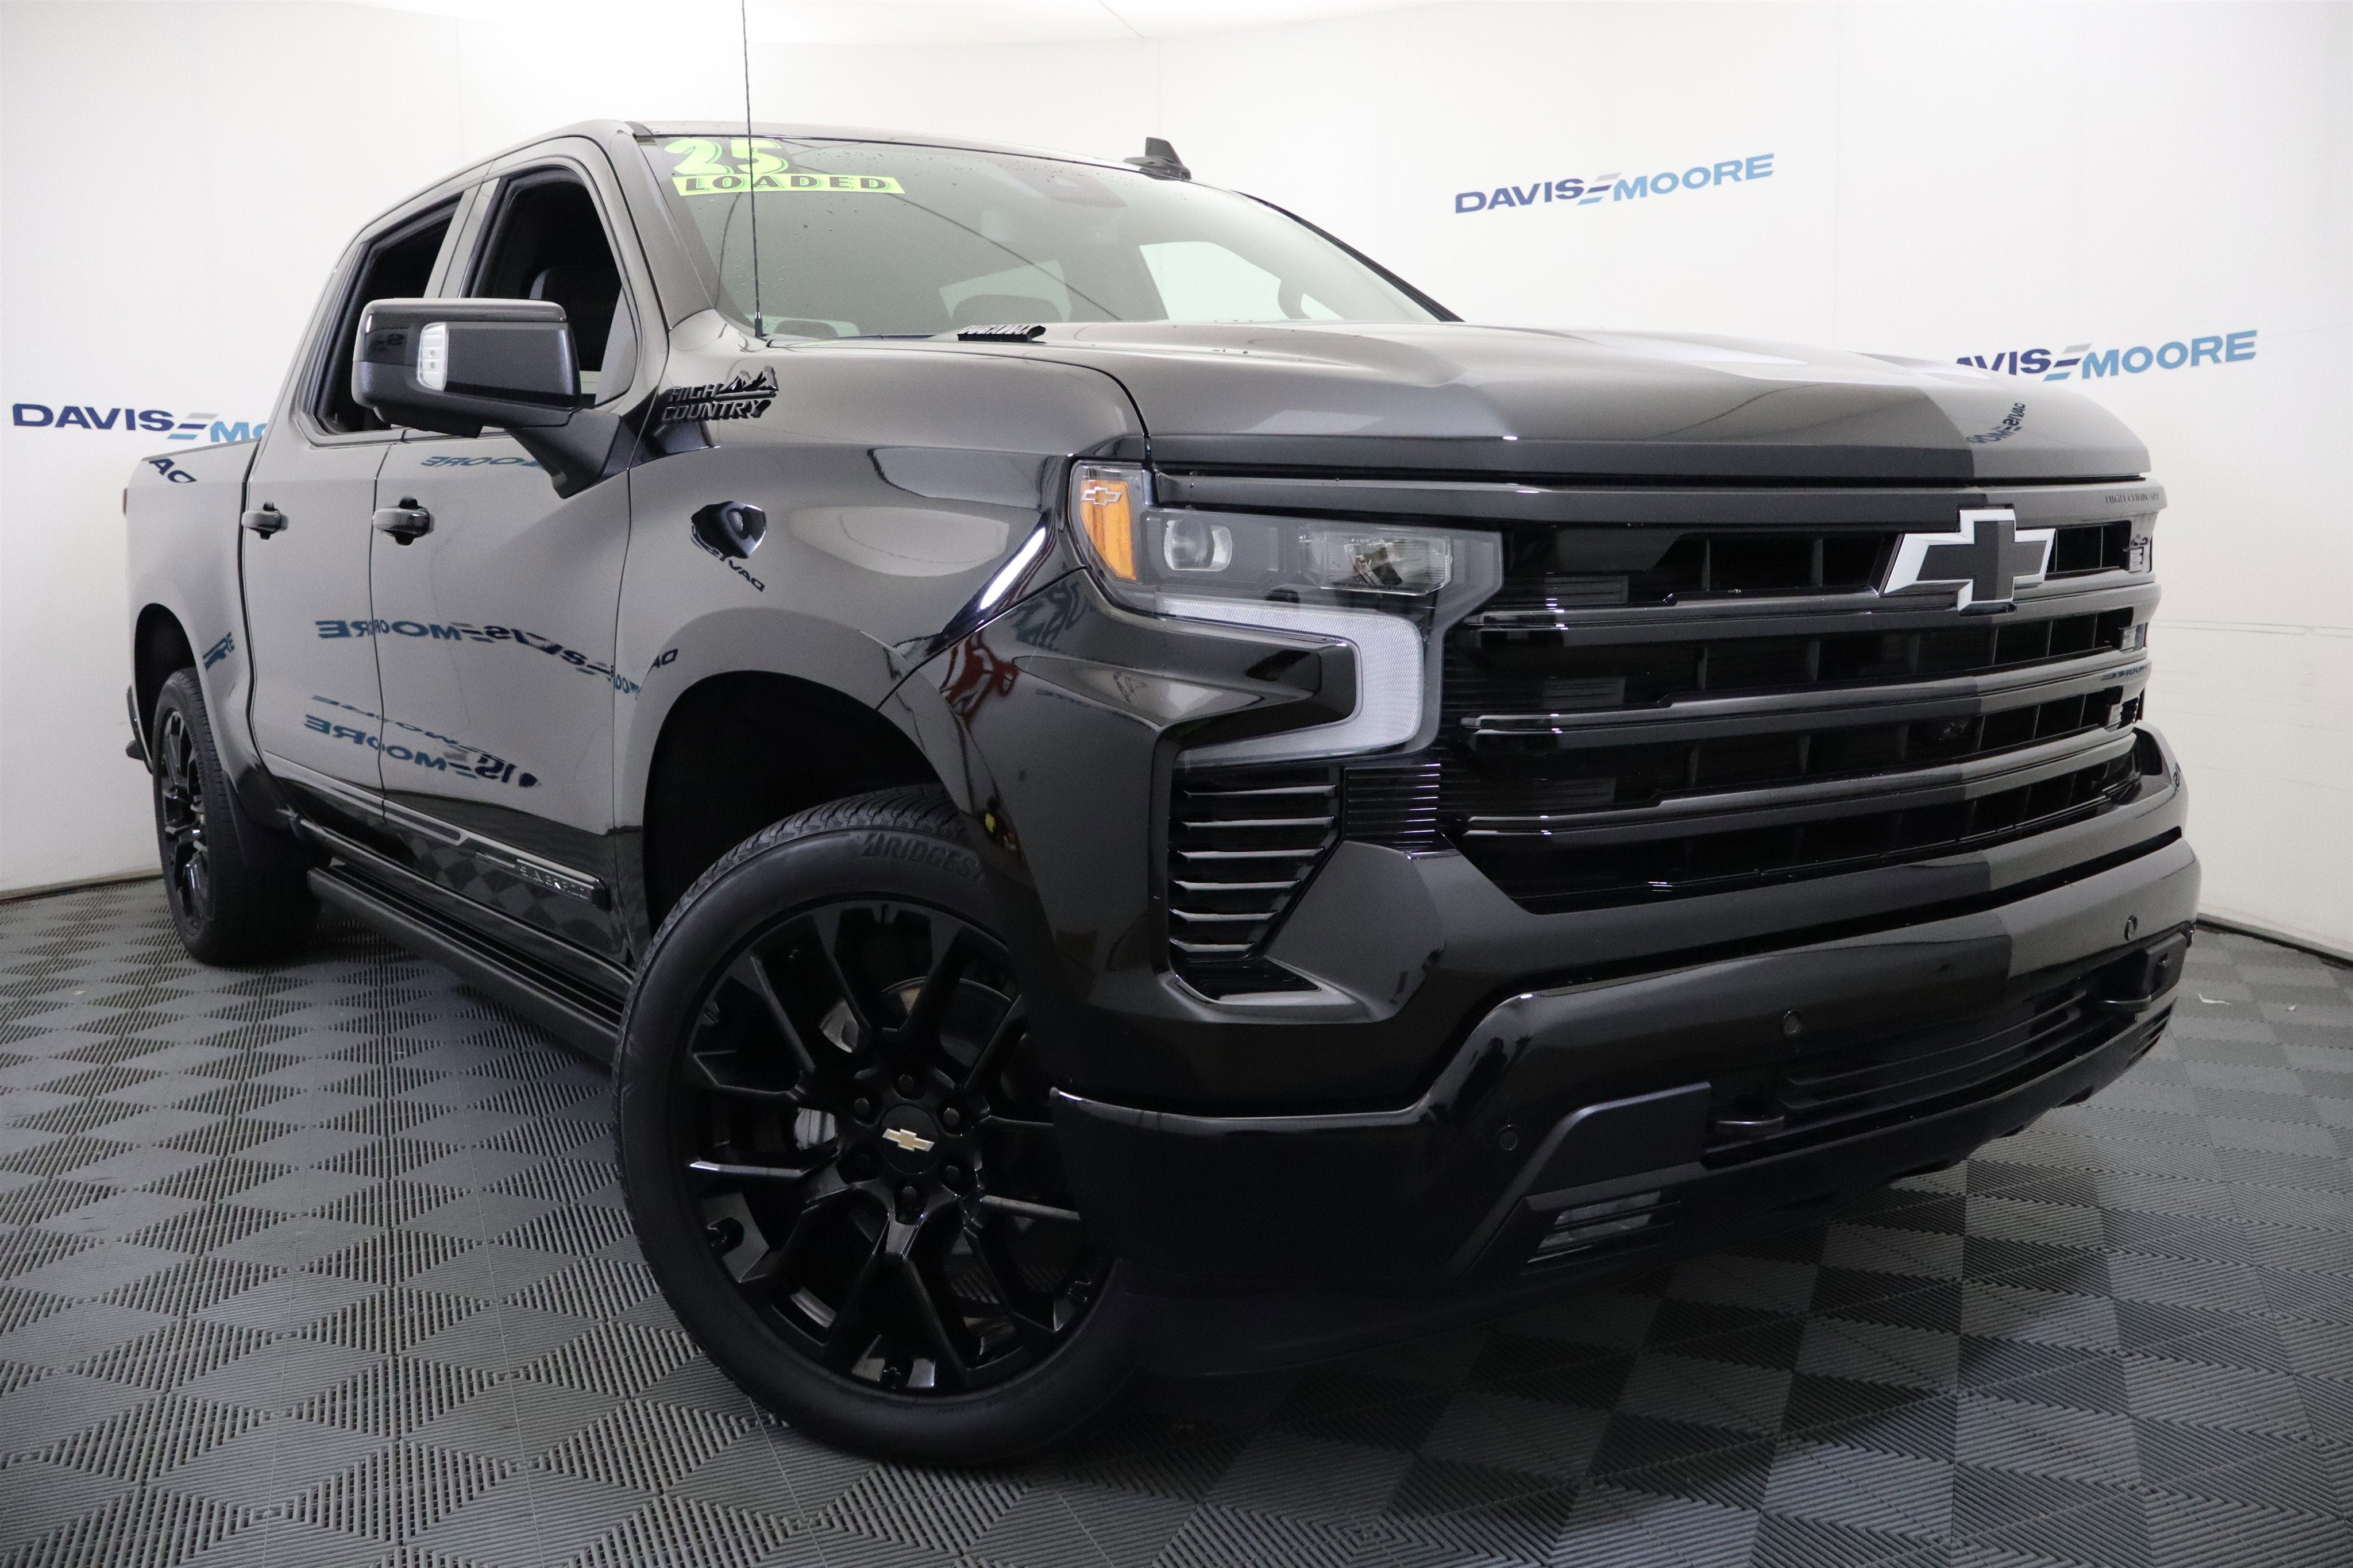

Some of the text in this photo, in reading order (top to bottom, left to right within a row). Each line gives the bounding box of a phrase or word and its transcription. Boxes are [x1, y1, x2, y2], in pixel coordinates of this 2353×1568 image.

[664, 138, 789, 175] 25
[685, 175, 891, 192] LOADED
[1455, 153, 1774, 214] DAVIS MOORE
[2082, 330, 2257, 379] MOORE
[668, 383, 725, 402] HIGH
[13, 403, 175, 431] DAVIS
[662, 399, 771, 422] COUNTRY
